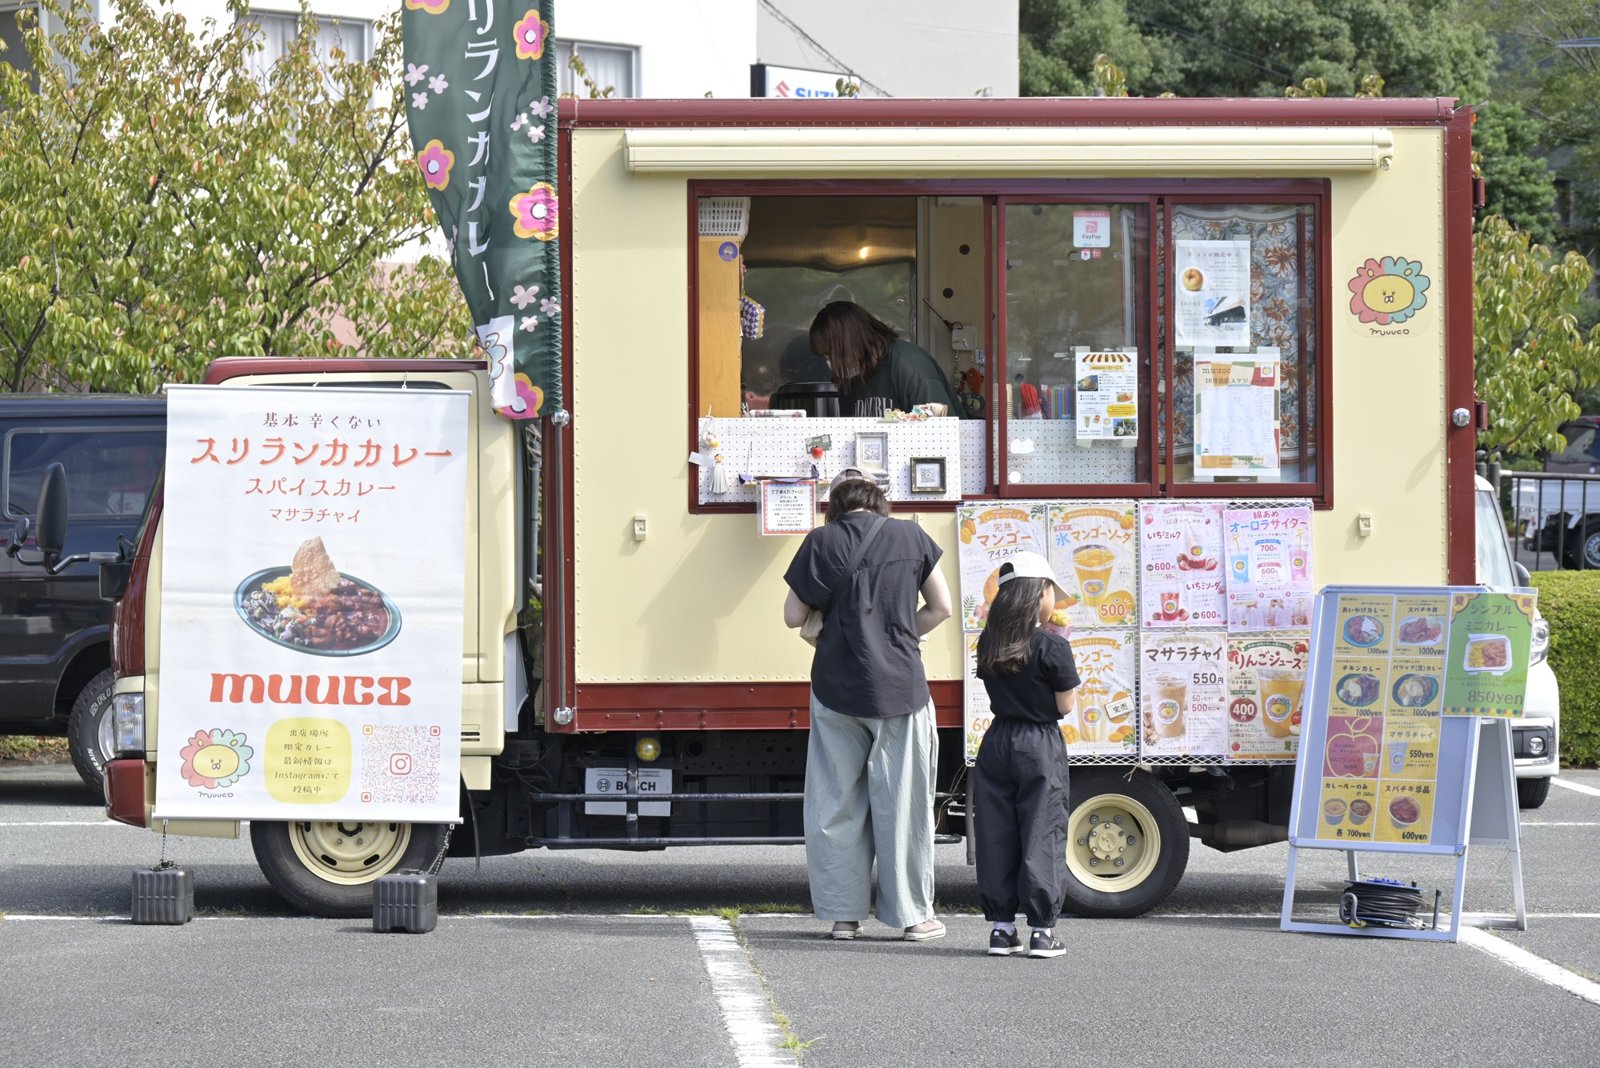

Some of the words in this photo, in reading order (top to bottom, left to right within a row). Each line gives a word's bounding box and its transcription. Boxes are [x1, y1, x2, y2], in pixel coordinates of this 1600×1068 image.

[263, 411, 299, 428] 基本
[309, 412, 382, 429] 辛くない
[189, 436, 454, 468] スリランカカレー
[244, 476, 396, 497] スパイスカレー
[269, 507, 361, 524] マサラチャイ
[1253, 510, 1280, 519] 綿あめ
[1230, 517, 1308, 533] オーロラサイダー
[976, 530, 1032, 547] マンゴー
[1056, 532, 1070, 546] 氷
[1071, 525, 1135, 544] マンゴーソーダ
[987, 547, 1025, 559] アイスバー
[1464, 620, 1518, 632] ミニカレー
[1145, 646, 1223, 662] マサラチャイ
[1234, 651, 1302, 670] りんごジュース
[1193, 673, 1224, 685] 550円
[208, 672, 412, 707] muuco
[1467, 690, 1523, 706] 850yen
[1232, 703, 1256, 716] 400
[289, 728, 329, 738] 出店場所
[1390, 731, 1434, 740] マサラチャイ
[283, 742, 333, 752] 限定カレー
[1409, 749, 1434, 759] 550yen
[1347, 829, 1371, 839] 700yen
[1401, 831, 1428, 841] 600yen
